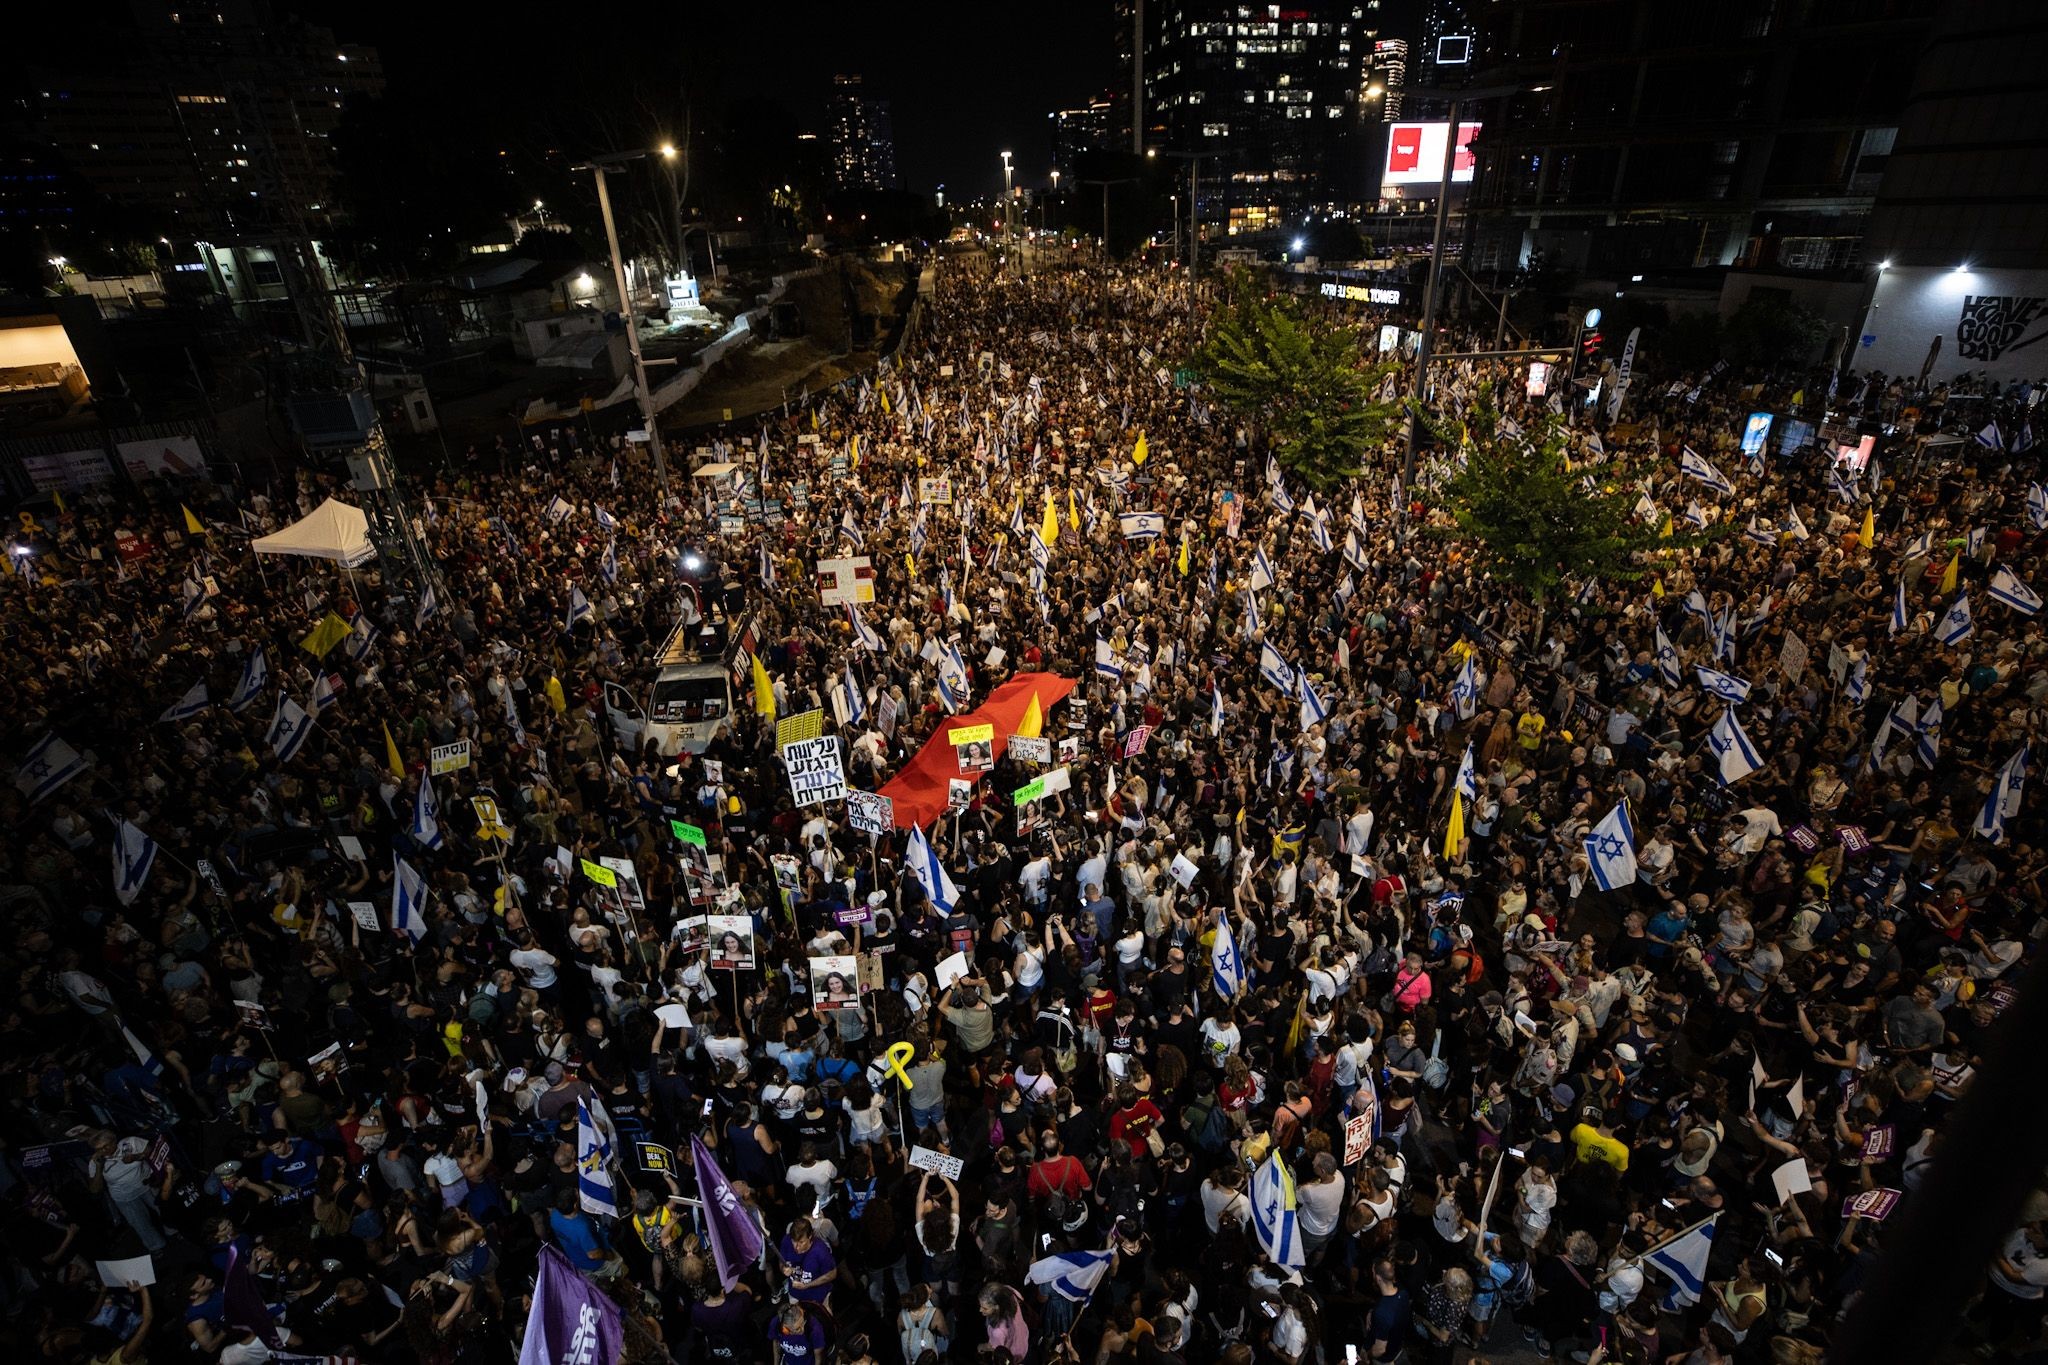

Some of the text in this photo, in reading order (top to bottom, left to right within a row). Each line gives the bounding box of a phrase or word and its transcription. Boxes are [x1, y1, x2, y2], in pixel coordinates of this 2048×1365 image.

[1370, 288, 1401, 305] TOWER
[433, 742, 467, 760] עסקה
[786, 738, 836, 767] עליונות
[790, 752, 840, 777] הגזע
[792, 767, 843, 791] איננה
[797, 782, 844, 805] יהדות
[647, 1160, 663, 1169] NOW
